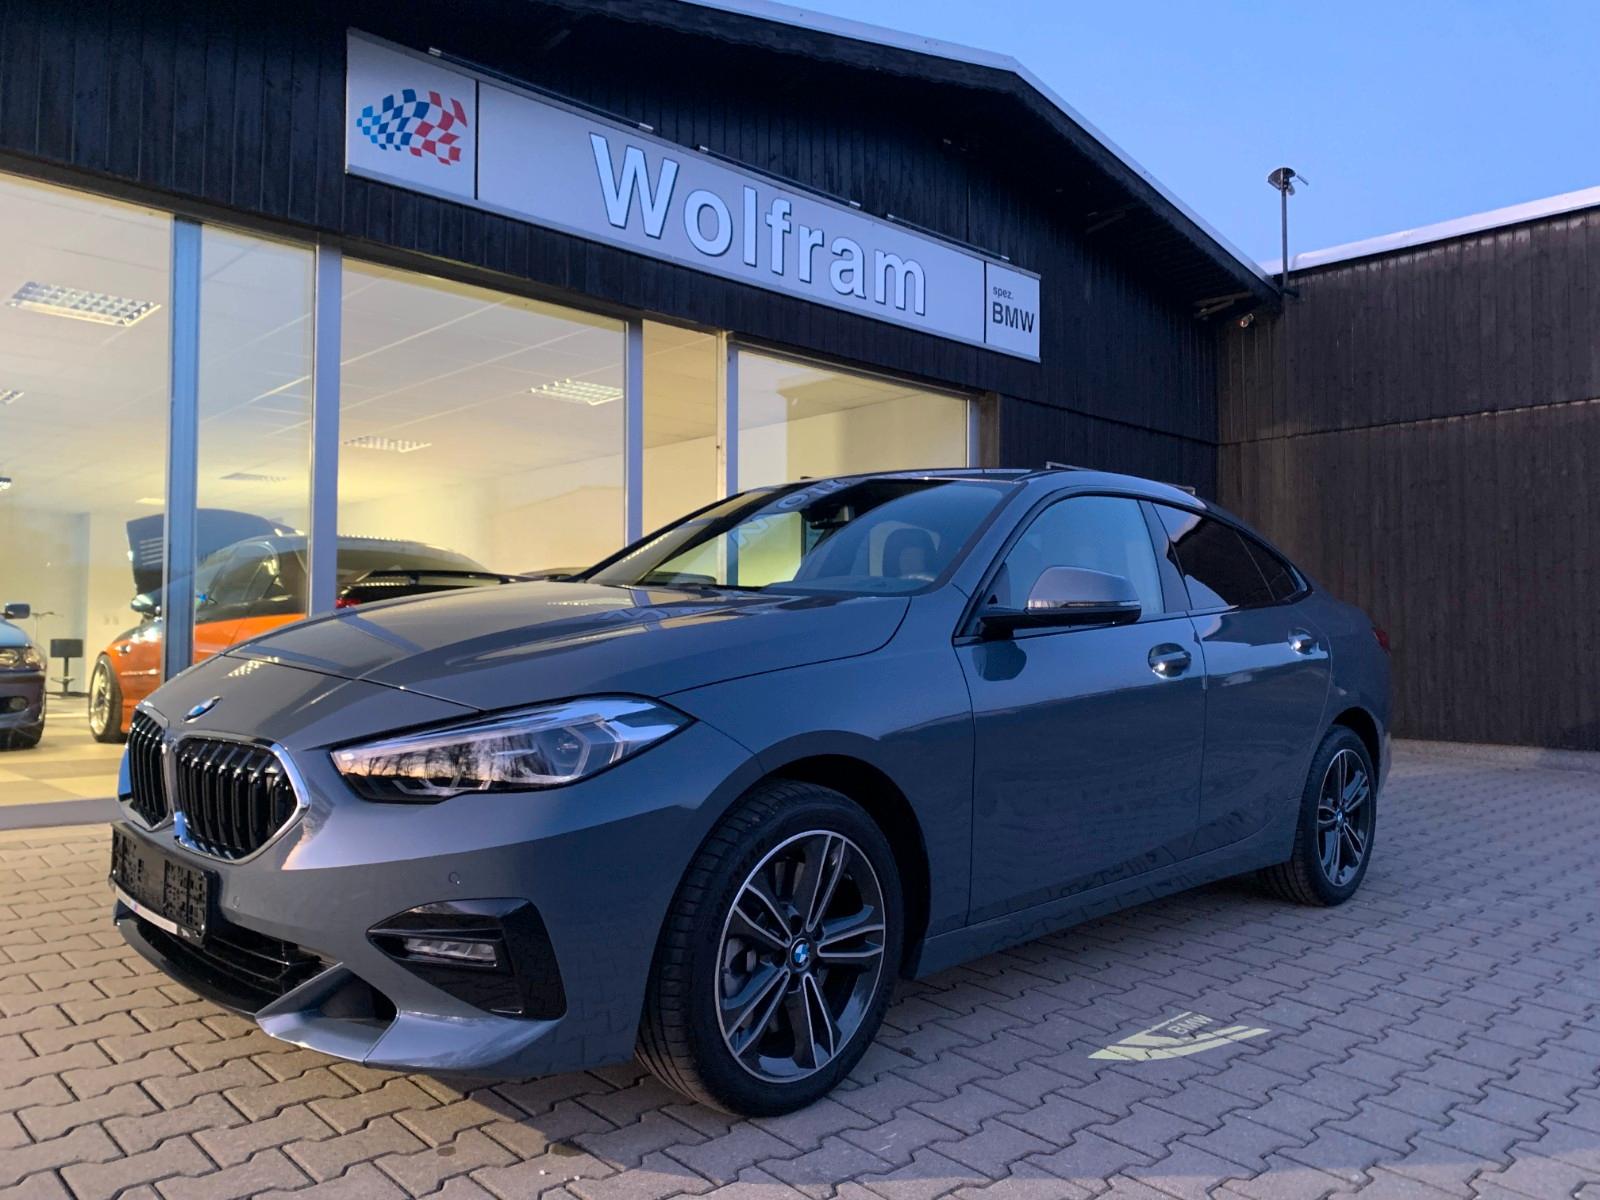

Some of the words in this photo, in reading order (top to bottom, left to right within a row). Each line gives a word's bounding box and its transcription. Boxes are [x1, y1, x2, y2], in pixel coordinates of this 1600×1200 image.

[589, 132, 926, 315] Wolfram
[992, 286, 1014, 299] spez.
[992, 301, 1034, 333] BMW
